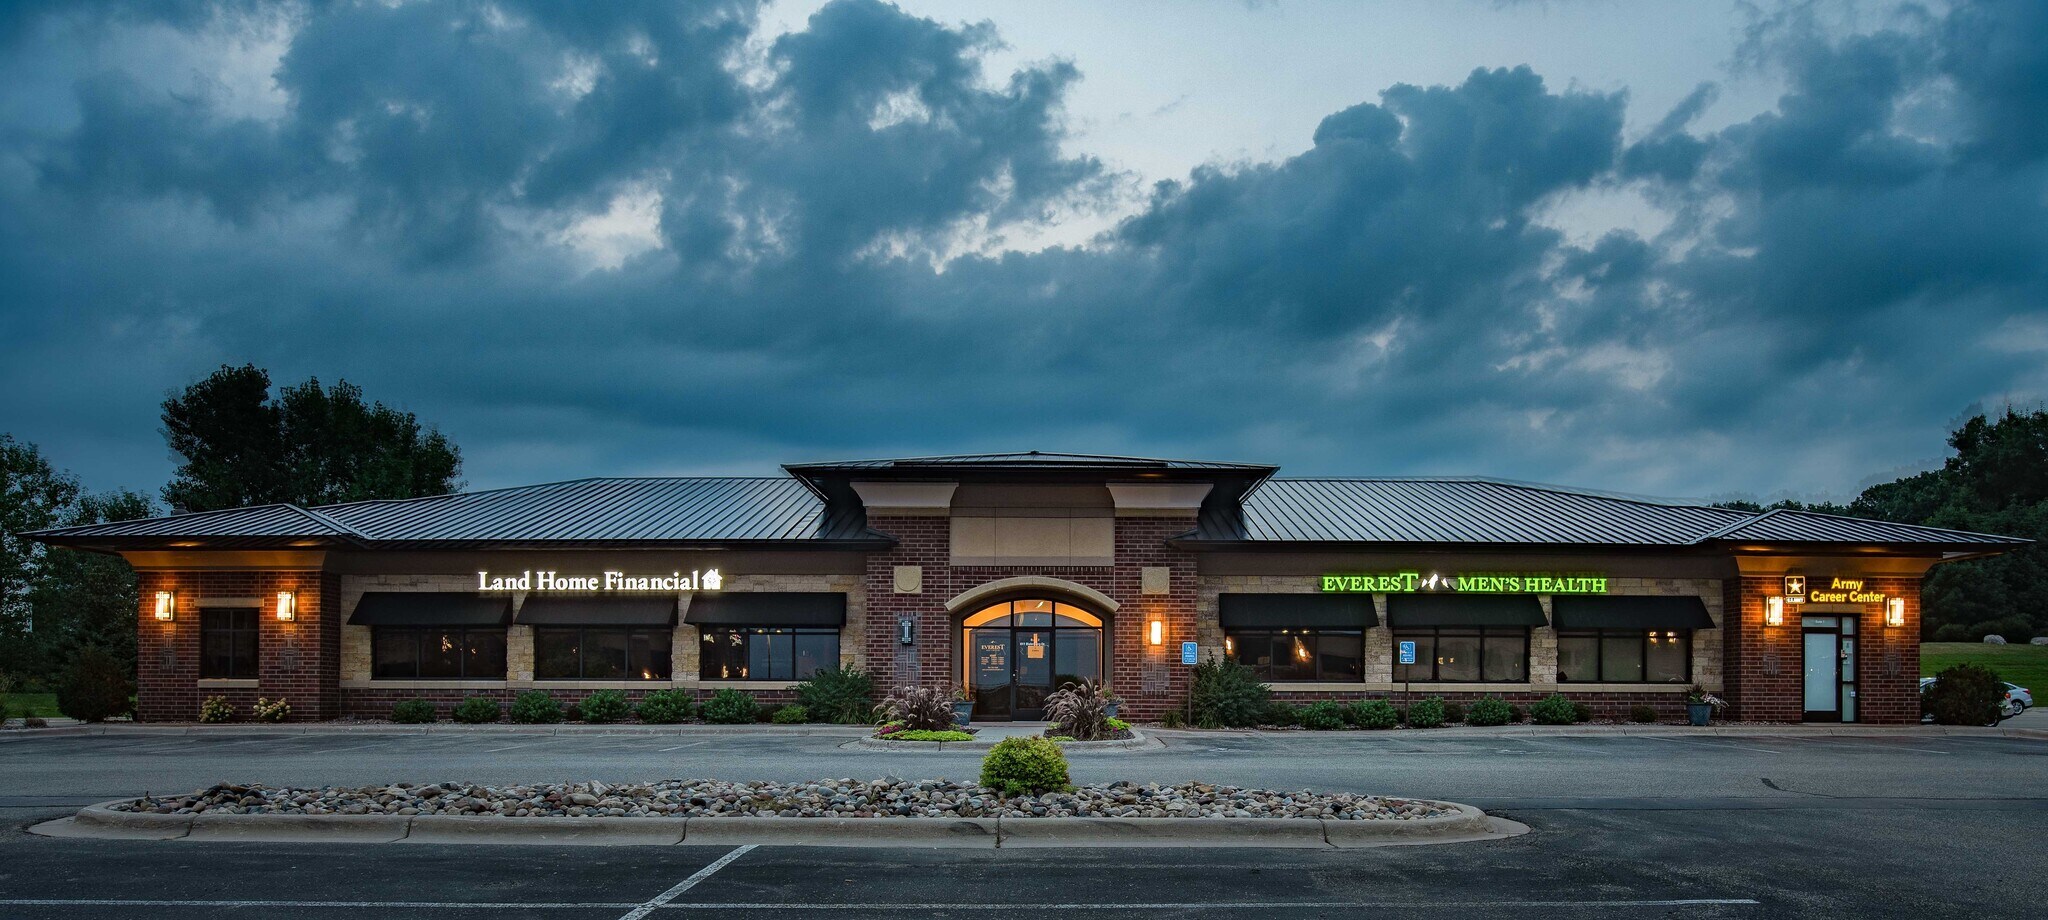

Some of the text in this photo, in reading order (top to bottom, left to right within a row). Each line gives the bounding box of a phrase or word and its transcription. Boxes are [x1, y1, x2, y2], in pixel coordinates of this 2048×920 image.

[478, 570, 700, 590] Land Home Financial
[1322, 573, 1607, 593] EVEREST MEN'S HEALTH
[1831, 577, 1864, 591] Army
[1810, 591, 1847, 603] Career
[1849, 591, 1886, 603] Center
